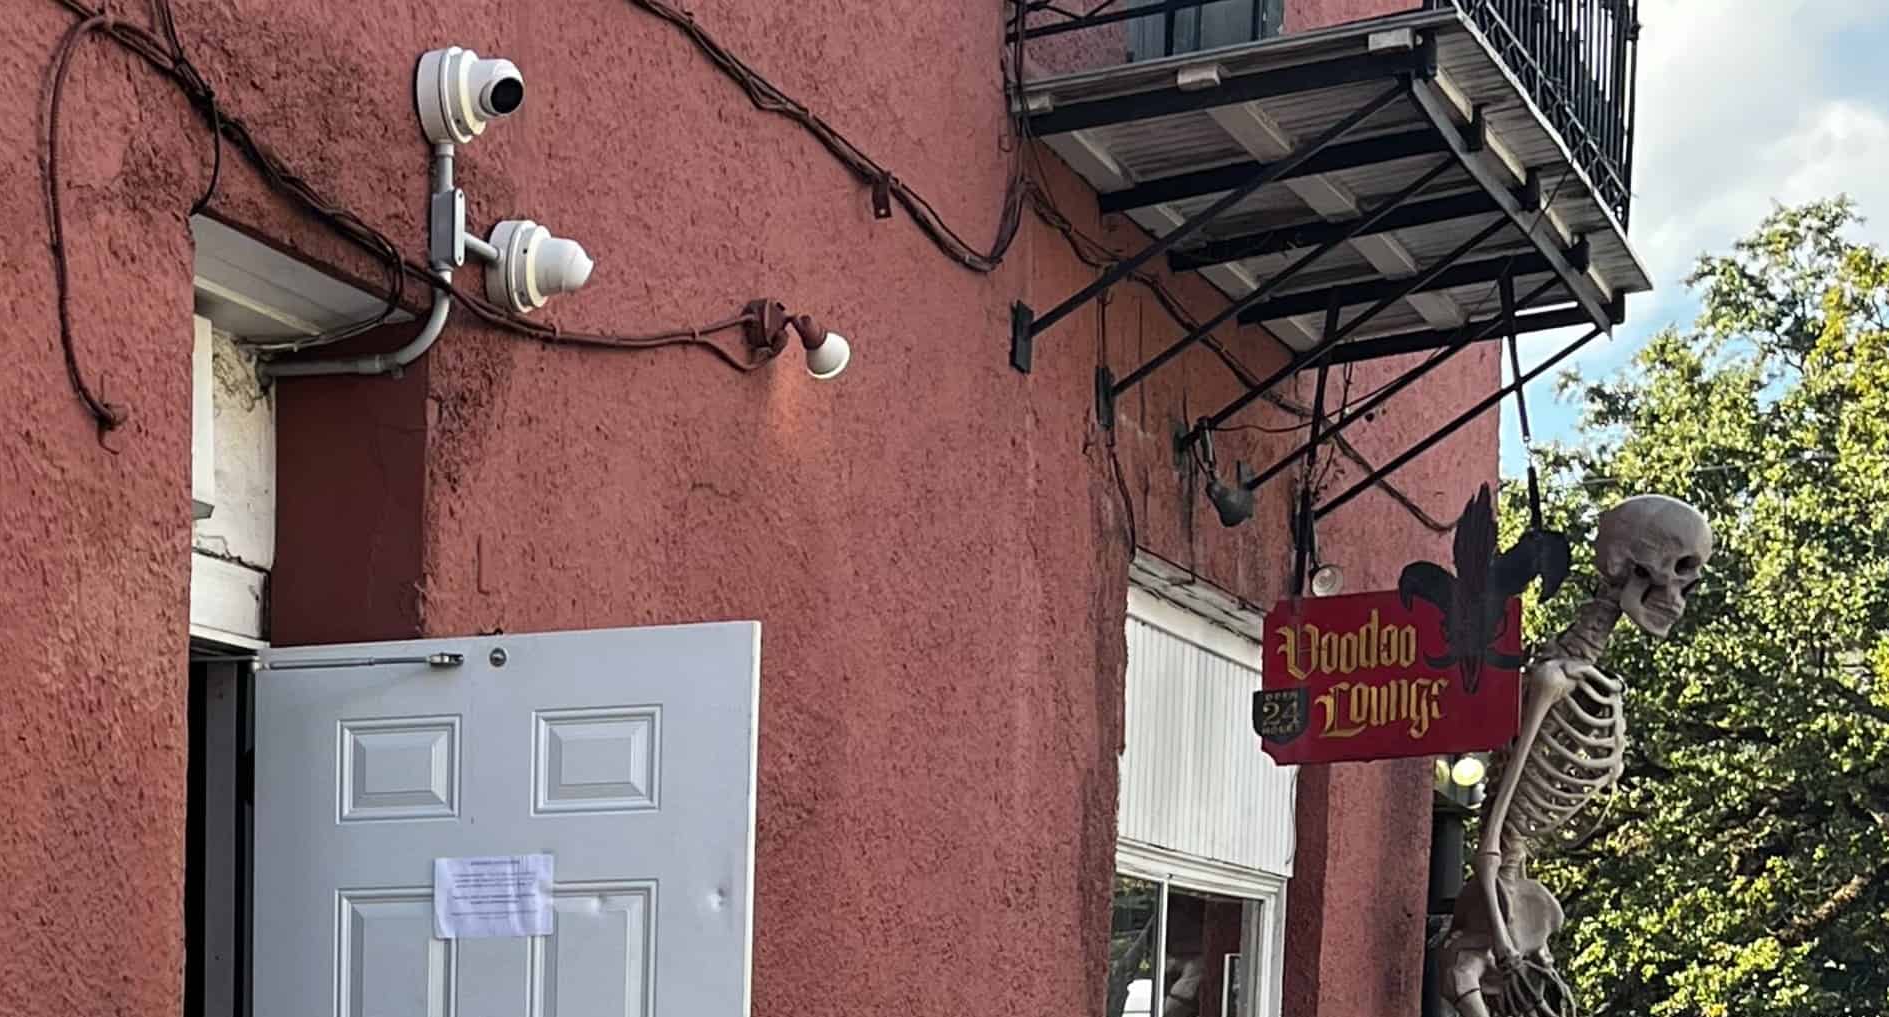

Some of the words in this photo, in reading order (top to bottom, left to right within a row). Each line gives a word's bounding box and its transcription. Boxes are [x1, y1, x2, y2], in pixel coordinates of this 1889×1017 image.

[1275, 608, 1418, 681] Voodoo
[1262, 701, 1300, 724] 24
[1315, 677, 1450, 739] Lounge
